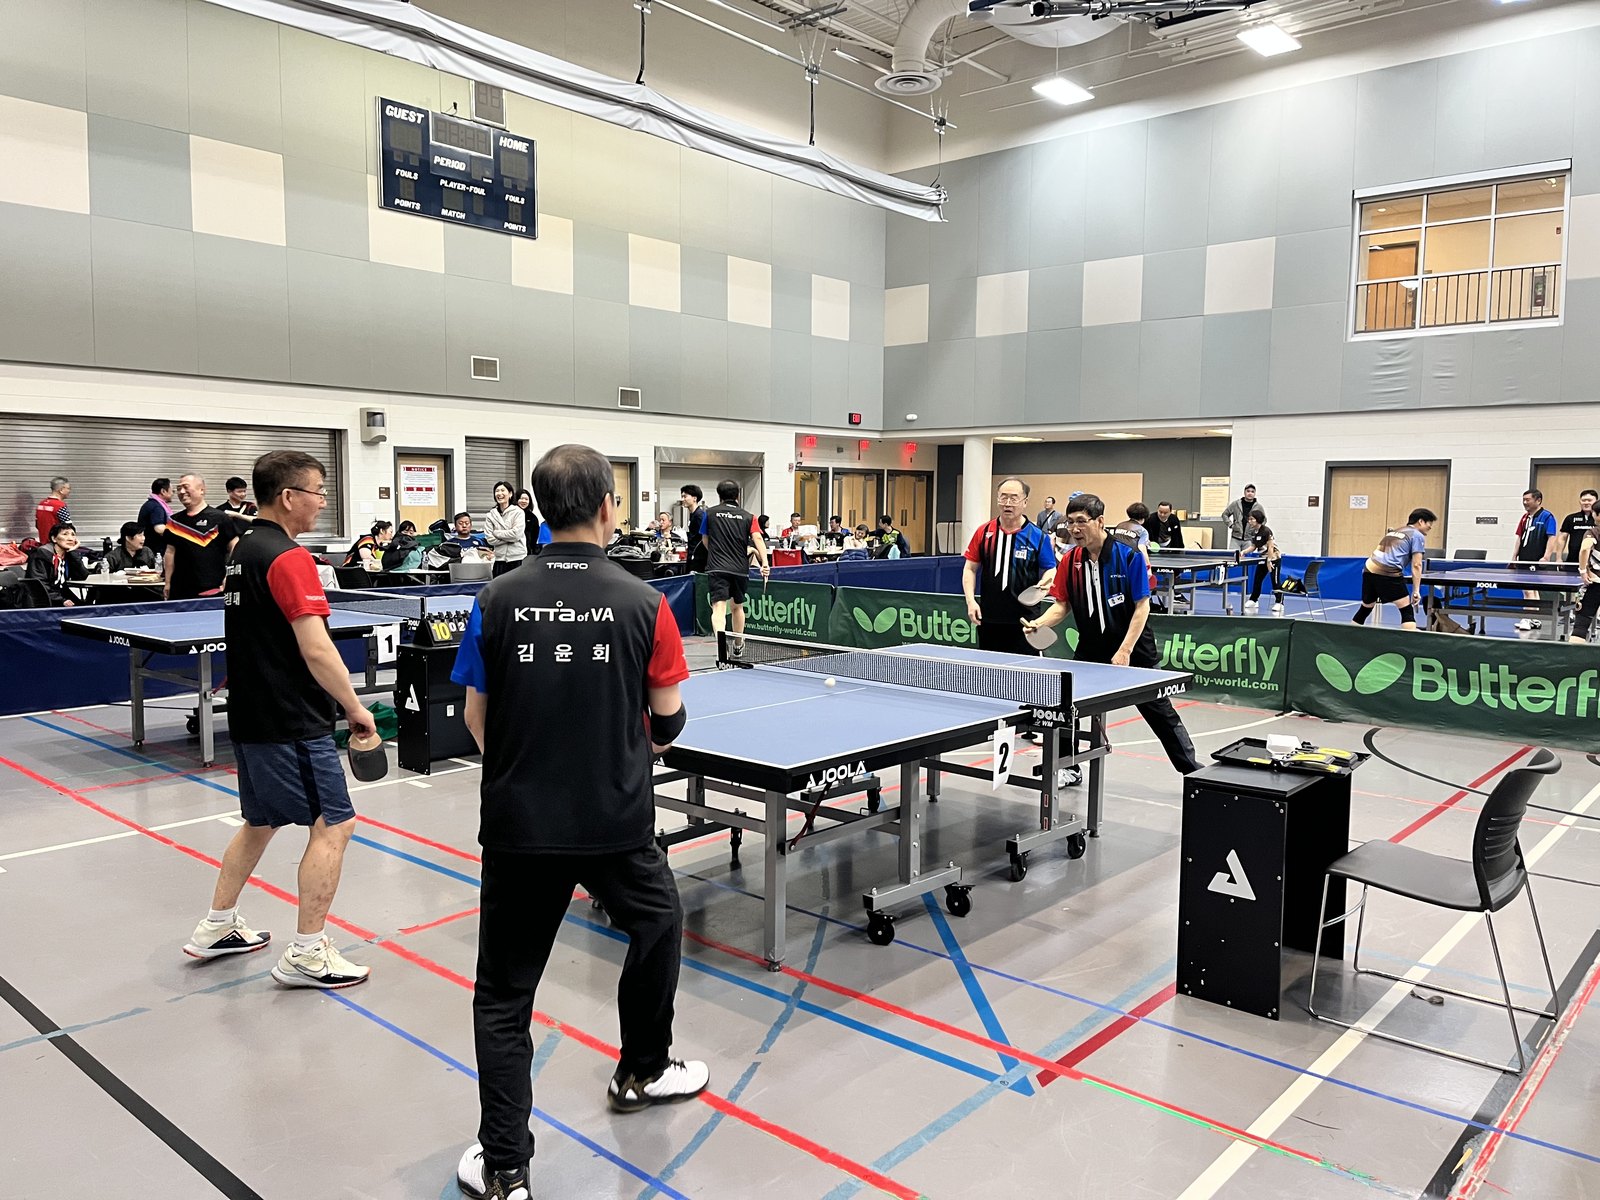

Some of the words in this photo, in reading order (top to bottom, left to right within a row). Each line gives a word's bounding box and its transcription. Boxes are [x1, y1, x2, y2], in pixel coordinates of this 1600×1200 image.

[385, 104, 425, 124] GUEST
[499, 136, 529, 153] HOME
[433, 155, 467, 171] PERIOD
[395, 168, 419, 180] FOULS
[439, 178, 486, 196] PLAYER-FOUL
[394, 198, 421, 210] POINTS
[504, 194, 525, 205] FOULS
[441, 208, 466, 219] MATCH
[504, 222, 527, 232] POINTS
[546, 562, 589, 570] TAGRO
[577, 612, 590, 622] of
[590, 607, 615, 622] VA
[744, 592, 817, 630] Butterfly
[432, 622, 452, 640] 10
[900, 608, 977, 644] Butter
[113, 636, 131, 647] JOOLA
[200, 642, 227, 653] JOO
[385, 634, 393, 653] 1
[517, 643, 534, 663] 김
[554, 643, 573, 662] 윤
[592, 643, 610, 663] 회
[1160, 633, 1280, 681] utterfly
[1163, 683, 1186, 698] JOOLA
[1412, 657, 1600, 718] Butterf
[1033, 708, 1065, 722] JOOLA
[998, 742, 1009, 774] 2
[819, 760, 868, 785] JOOLA
